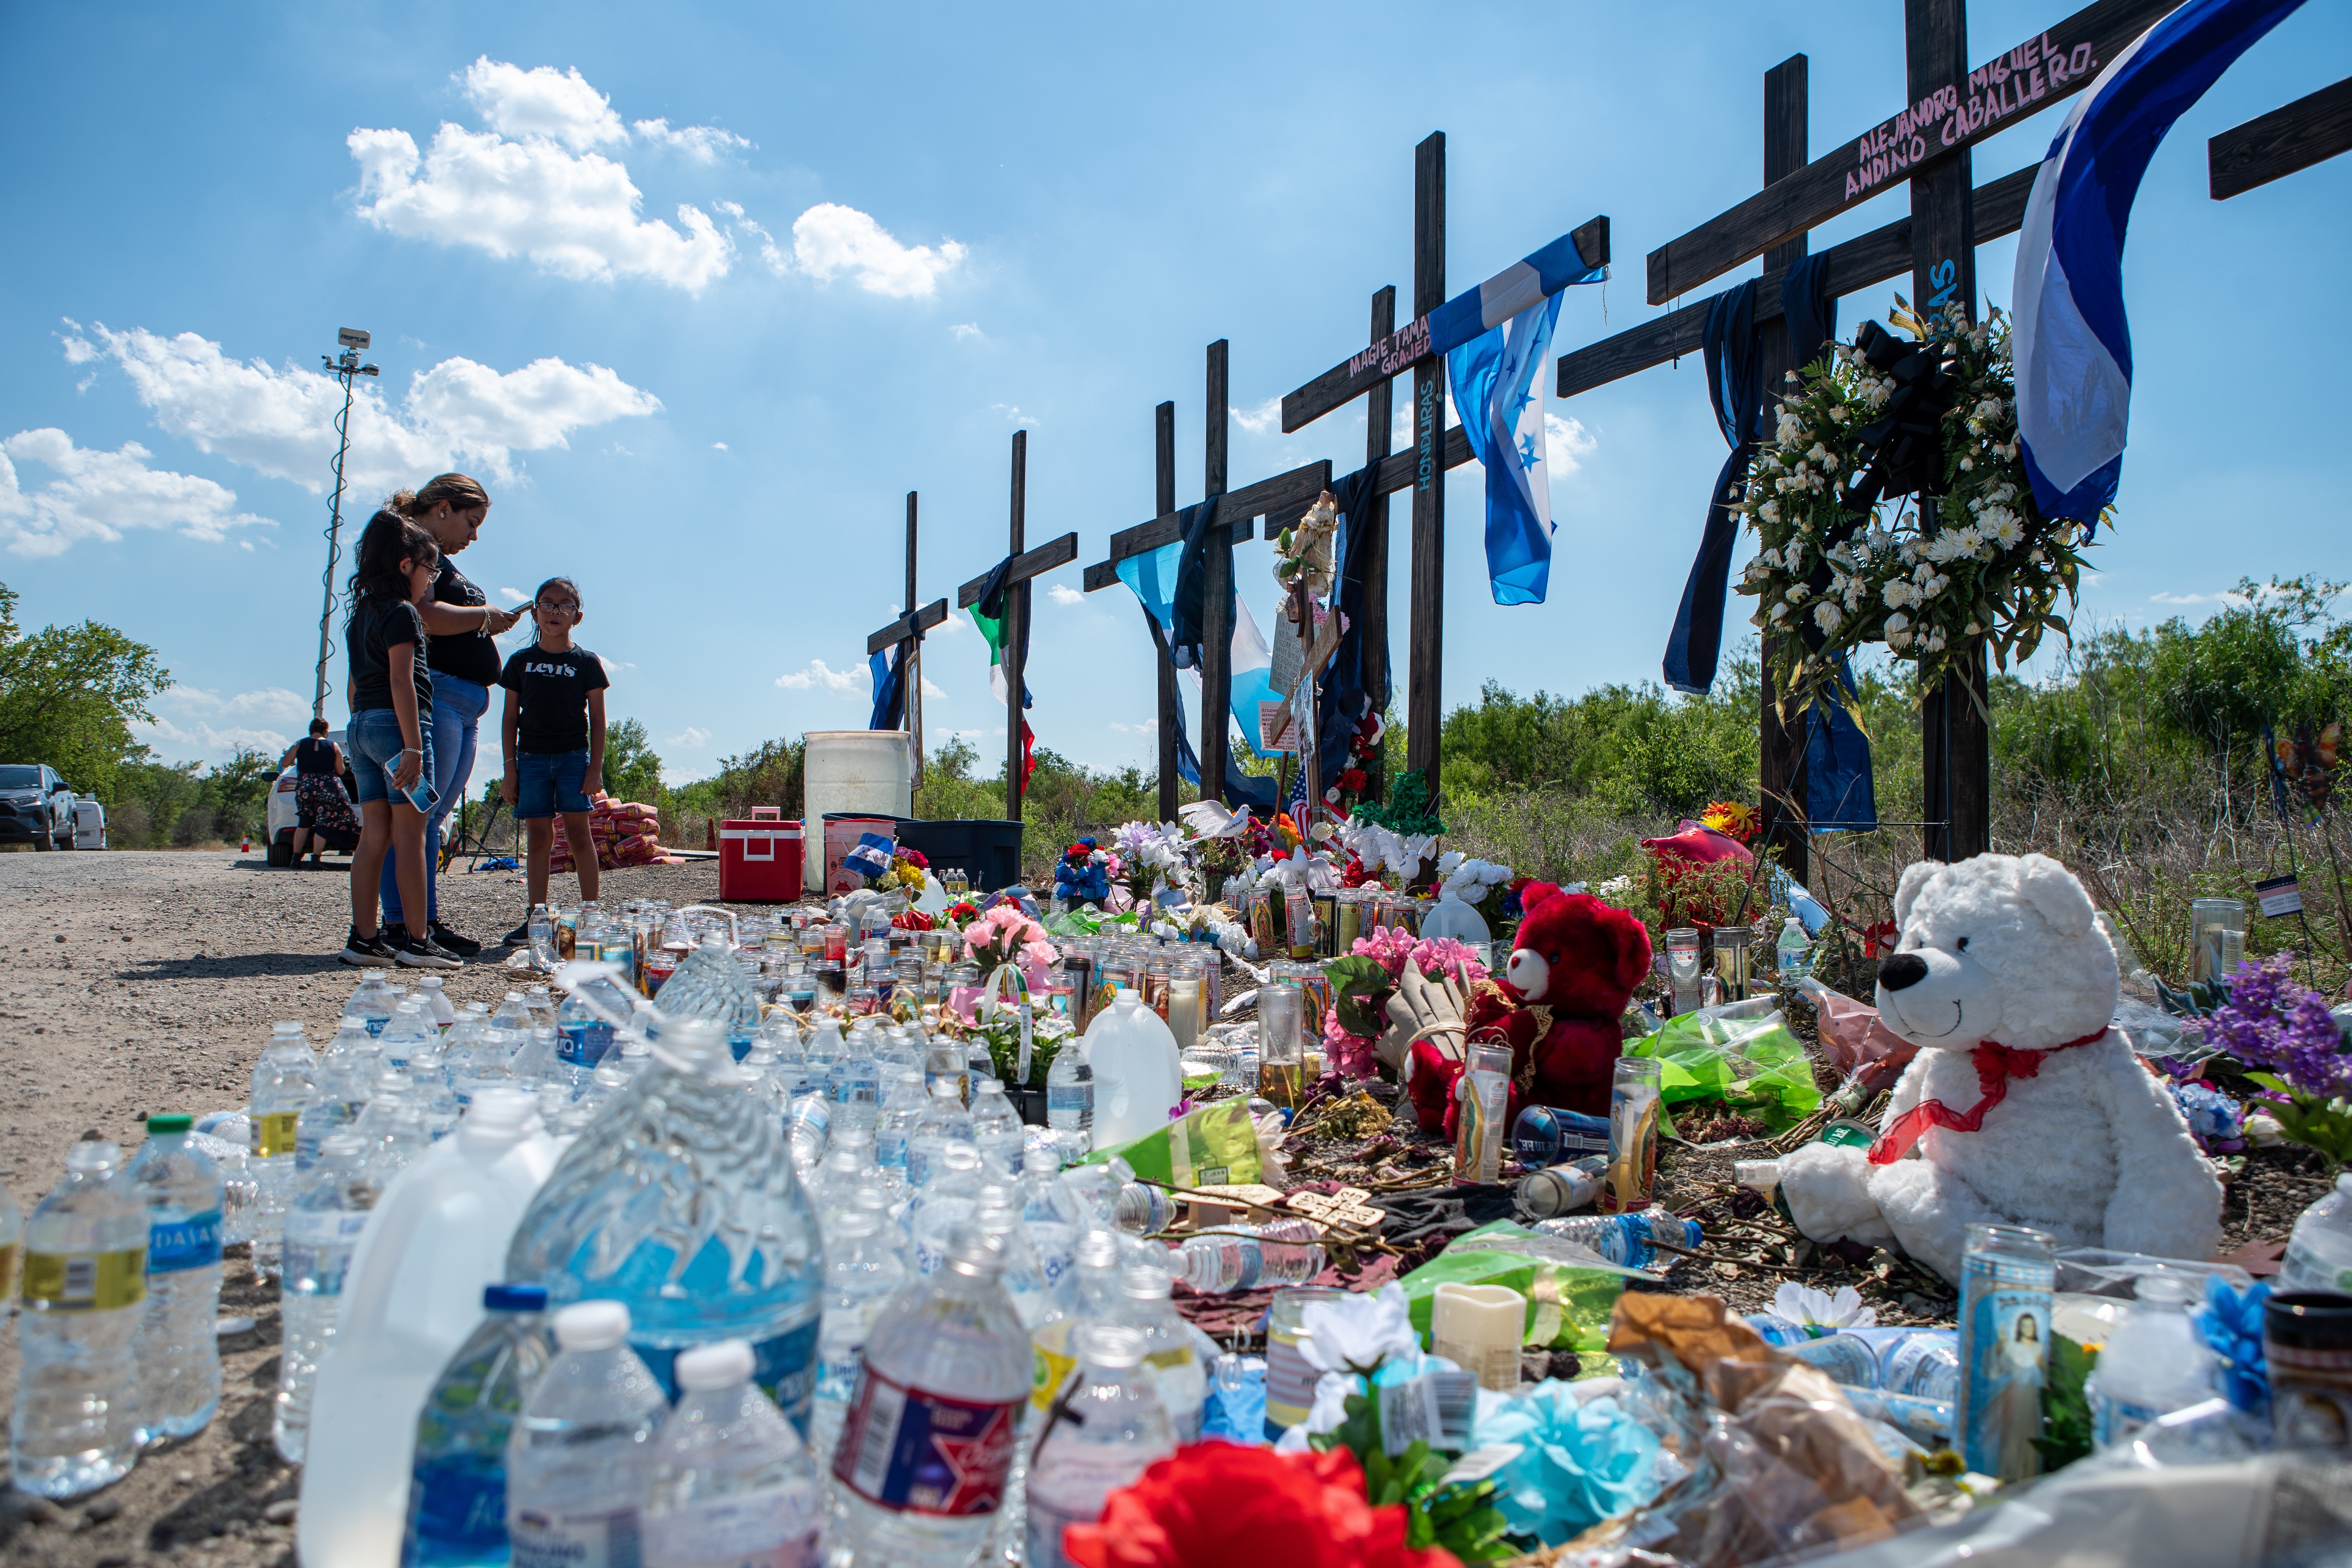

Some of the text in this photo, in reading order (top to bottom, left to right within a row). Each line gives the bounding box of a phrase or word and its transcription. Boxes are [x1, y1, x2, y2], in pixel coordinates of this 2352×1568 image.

[1845, 42, 2098, 201] ANDINO CABALLERO.
[1859, 31, 2060, 163] ALEJANDRO MIGUEL
[1349, 316, 1430, 377] MAGIE TAMA
[1381, 334, 1431, 375] GRAJED
[1419, 380, 1433, 491] HONDURAS
[1278, 630, 1285, 638] NO
[1272, 675, 1283, 684] ANTES
[1274, 661, 1283, 671] POR
